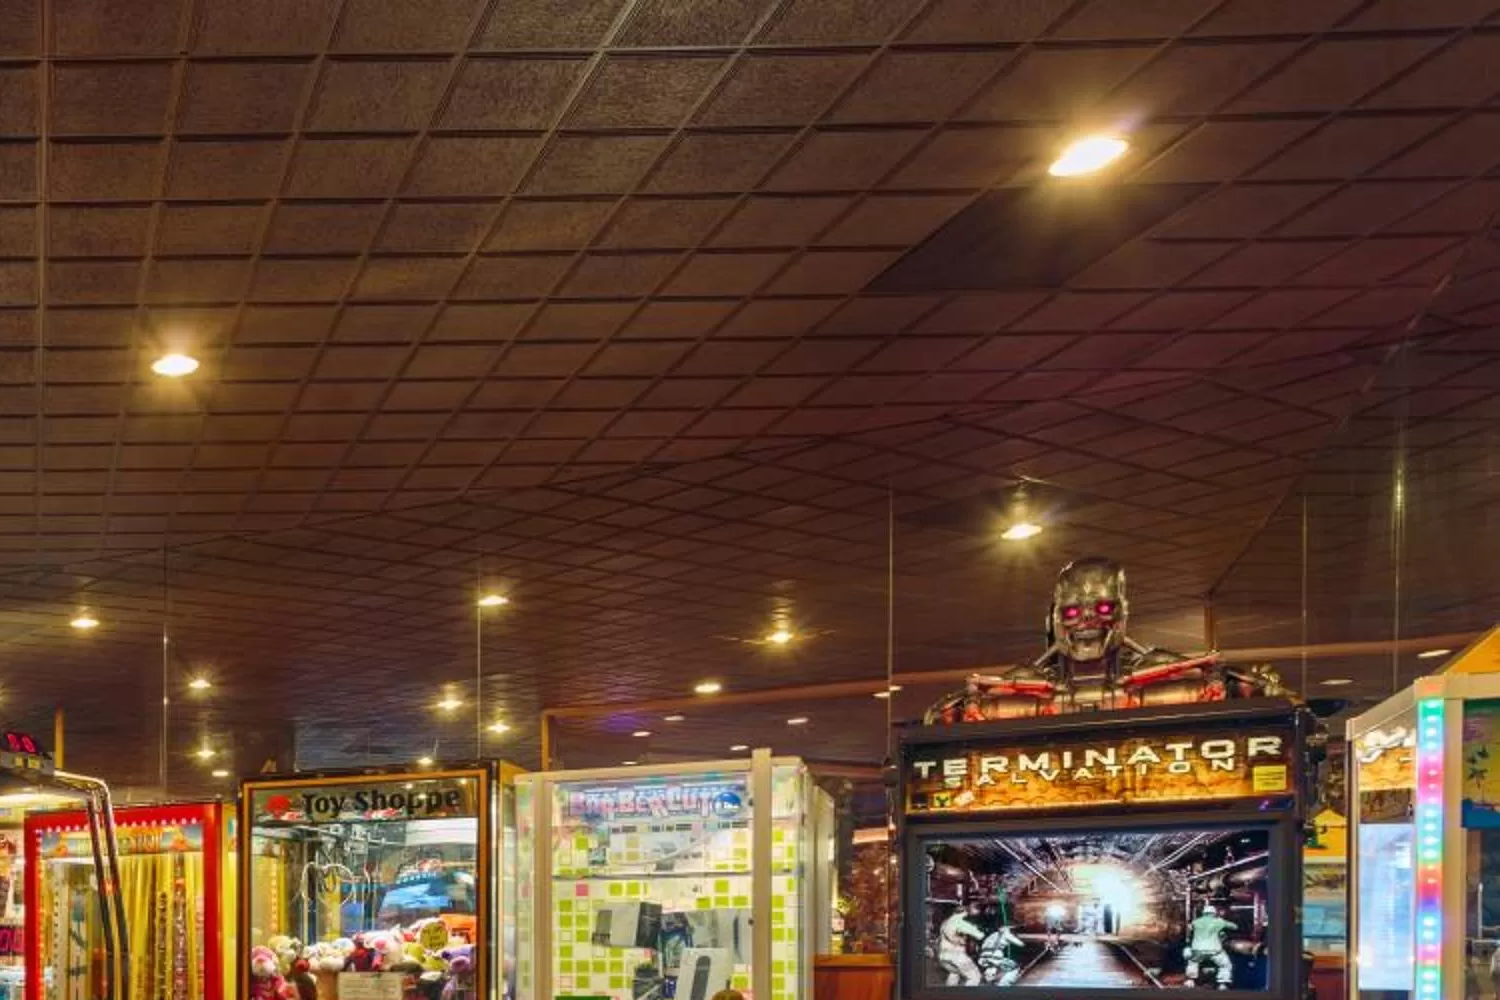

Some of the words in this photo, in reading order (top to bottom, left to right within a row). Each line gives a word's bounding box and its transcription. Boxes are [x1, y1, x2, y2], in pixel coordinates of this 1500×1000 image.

[913, 735, 1283, 779] TERMINATOR
[943, 757, 1235, 789] SALVATION
[302, 792, 346, 818] Toy
[354, 788, 461, 815] Shoppe
